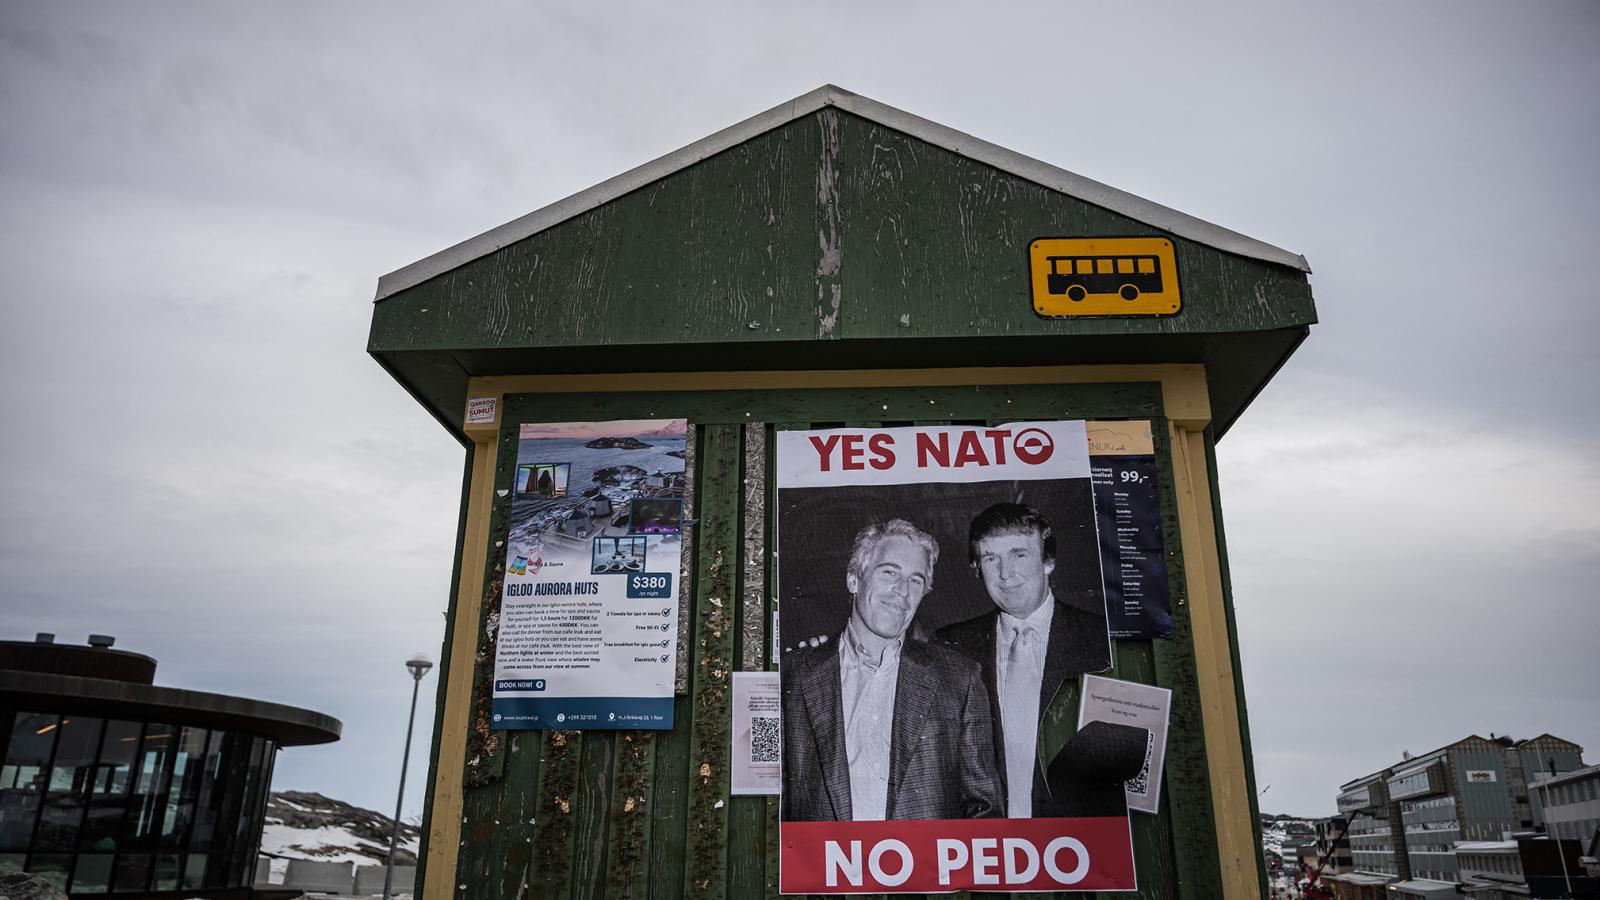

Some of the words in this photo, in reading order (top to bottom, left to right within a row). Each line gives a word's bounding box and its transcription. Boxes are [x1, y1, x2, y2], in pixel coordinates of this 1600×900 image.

[808, 433, 896, 472] YES
[916, 428, 1054, 468] NATO
[507, 583, 532, 596] IGLOO
[535, 583, 572, 596] AURORA
[574, 582, 599, 595] HUTS
[633, 576, 666, 589] $380
[825, 838, 914, 887] NO
[936, 836, 1090, 886] PEDO
